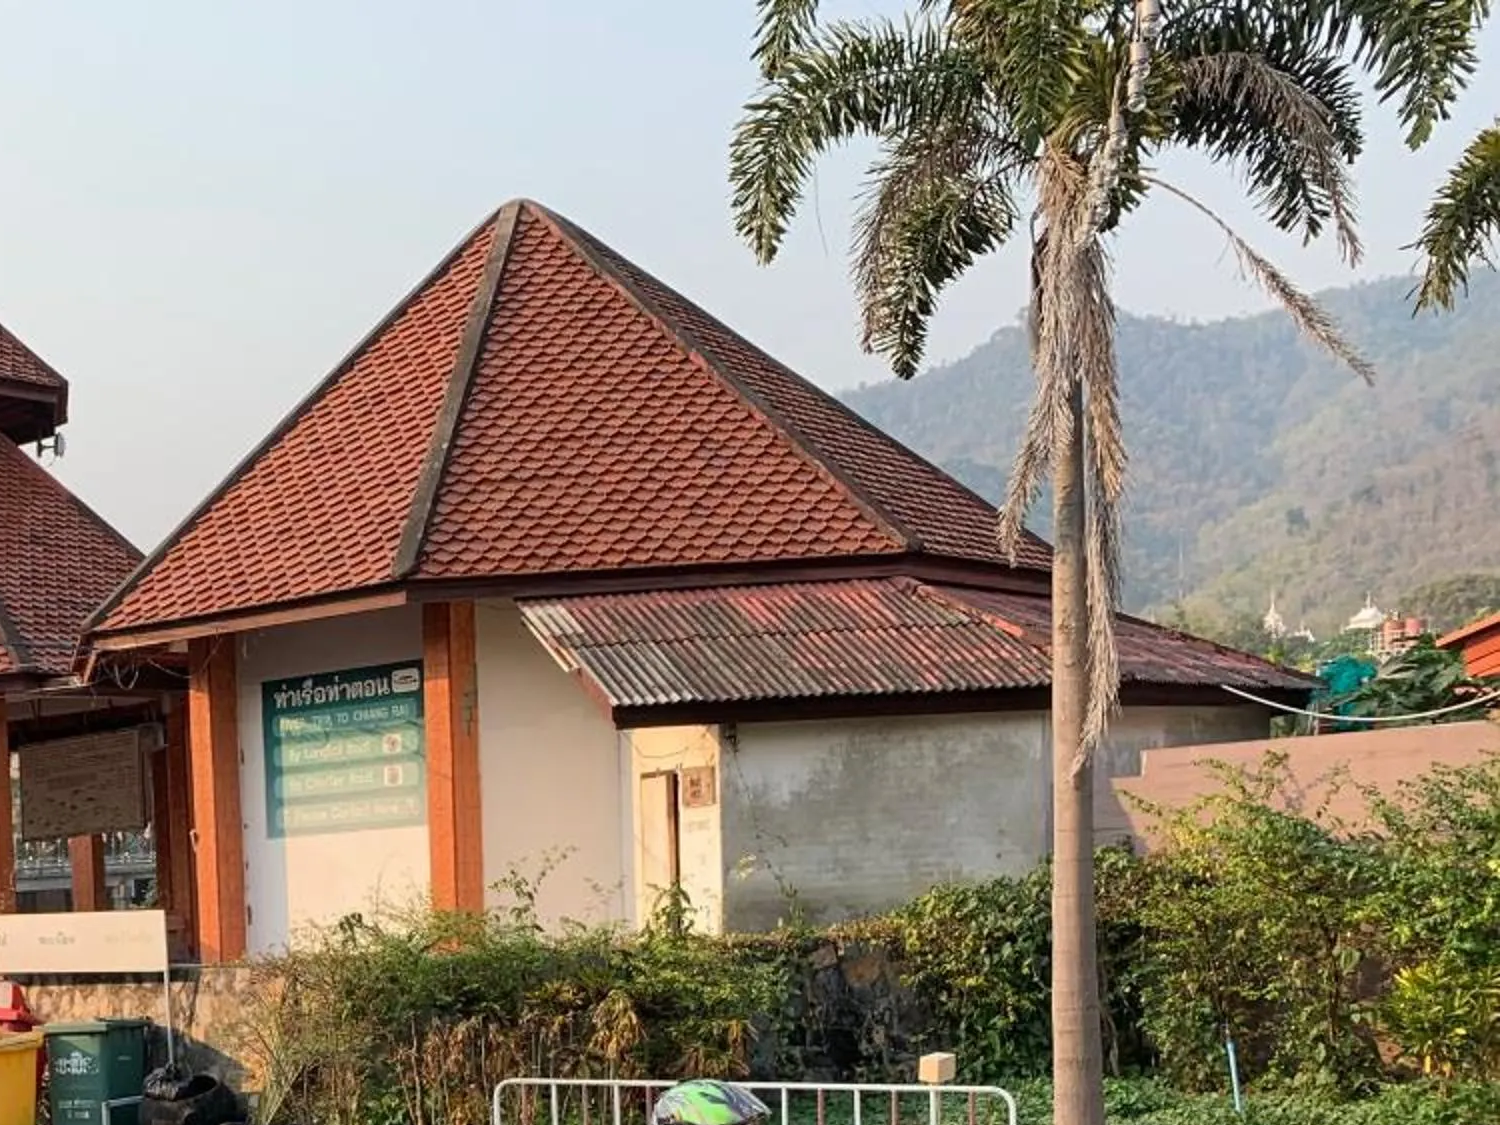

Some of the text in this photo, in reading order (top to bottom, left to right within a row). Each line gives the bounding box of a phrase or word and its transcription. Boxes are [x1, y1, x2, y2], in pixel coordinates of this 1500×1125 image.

[273, 675, 390, 708] ท่าเรือท่าตอน
